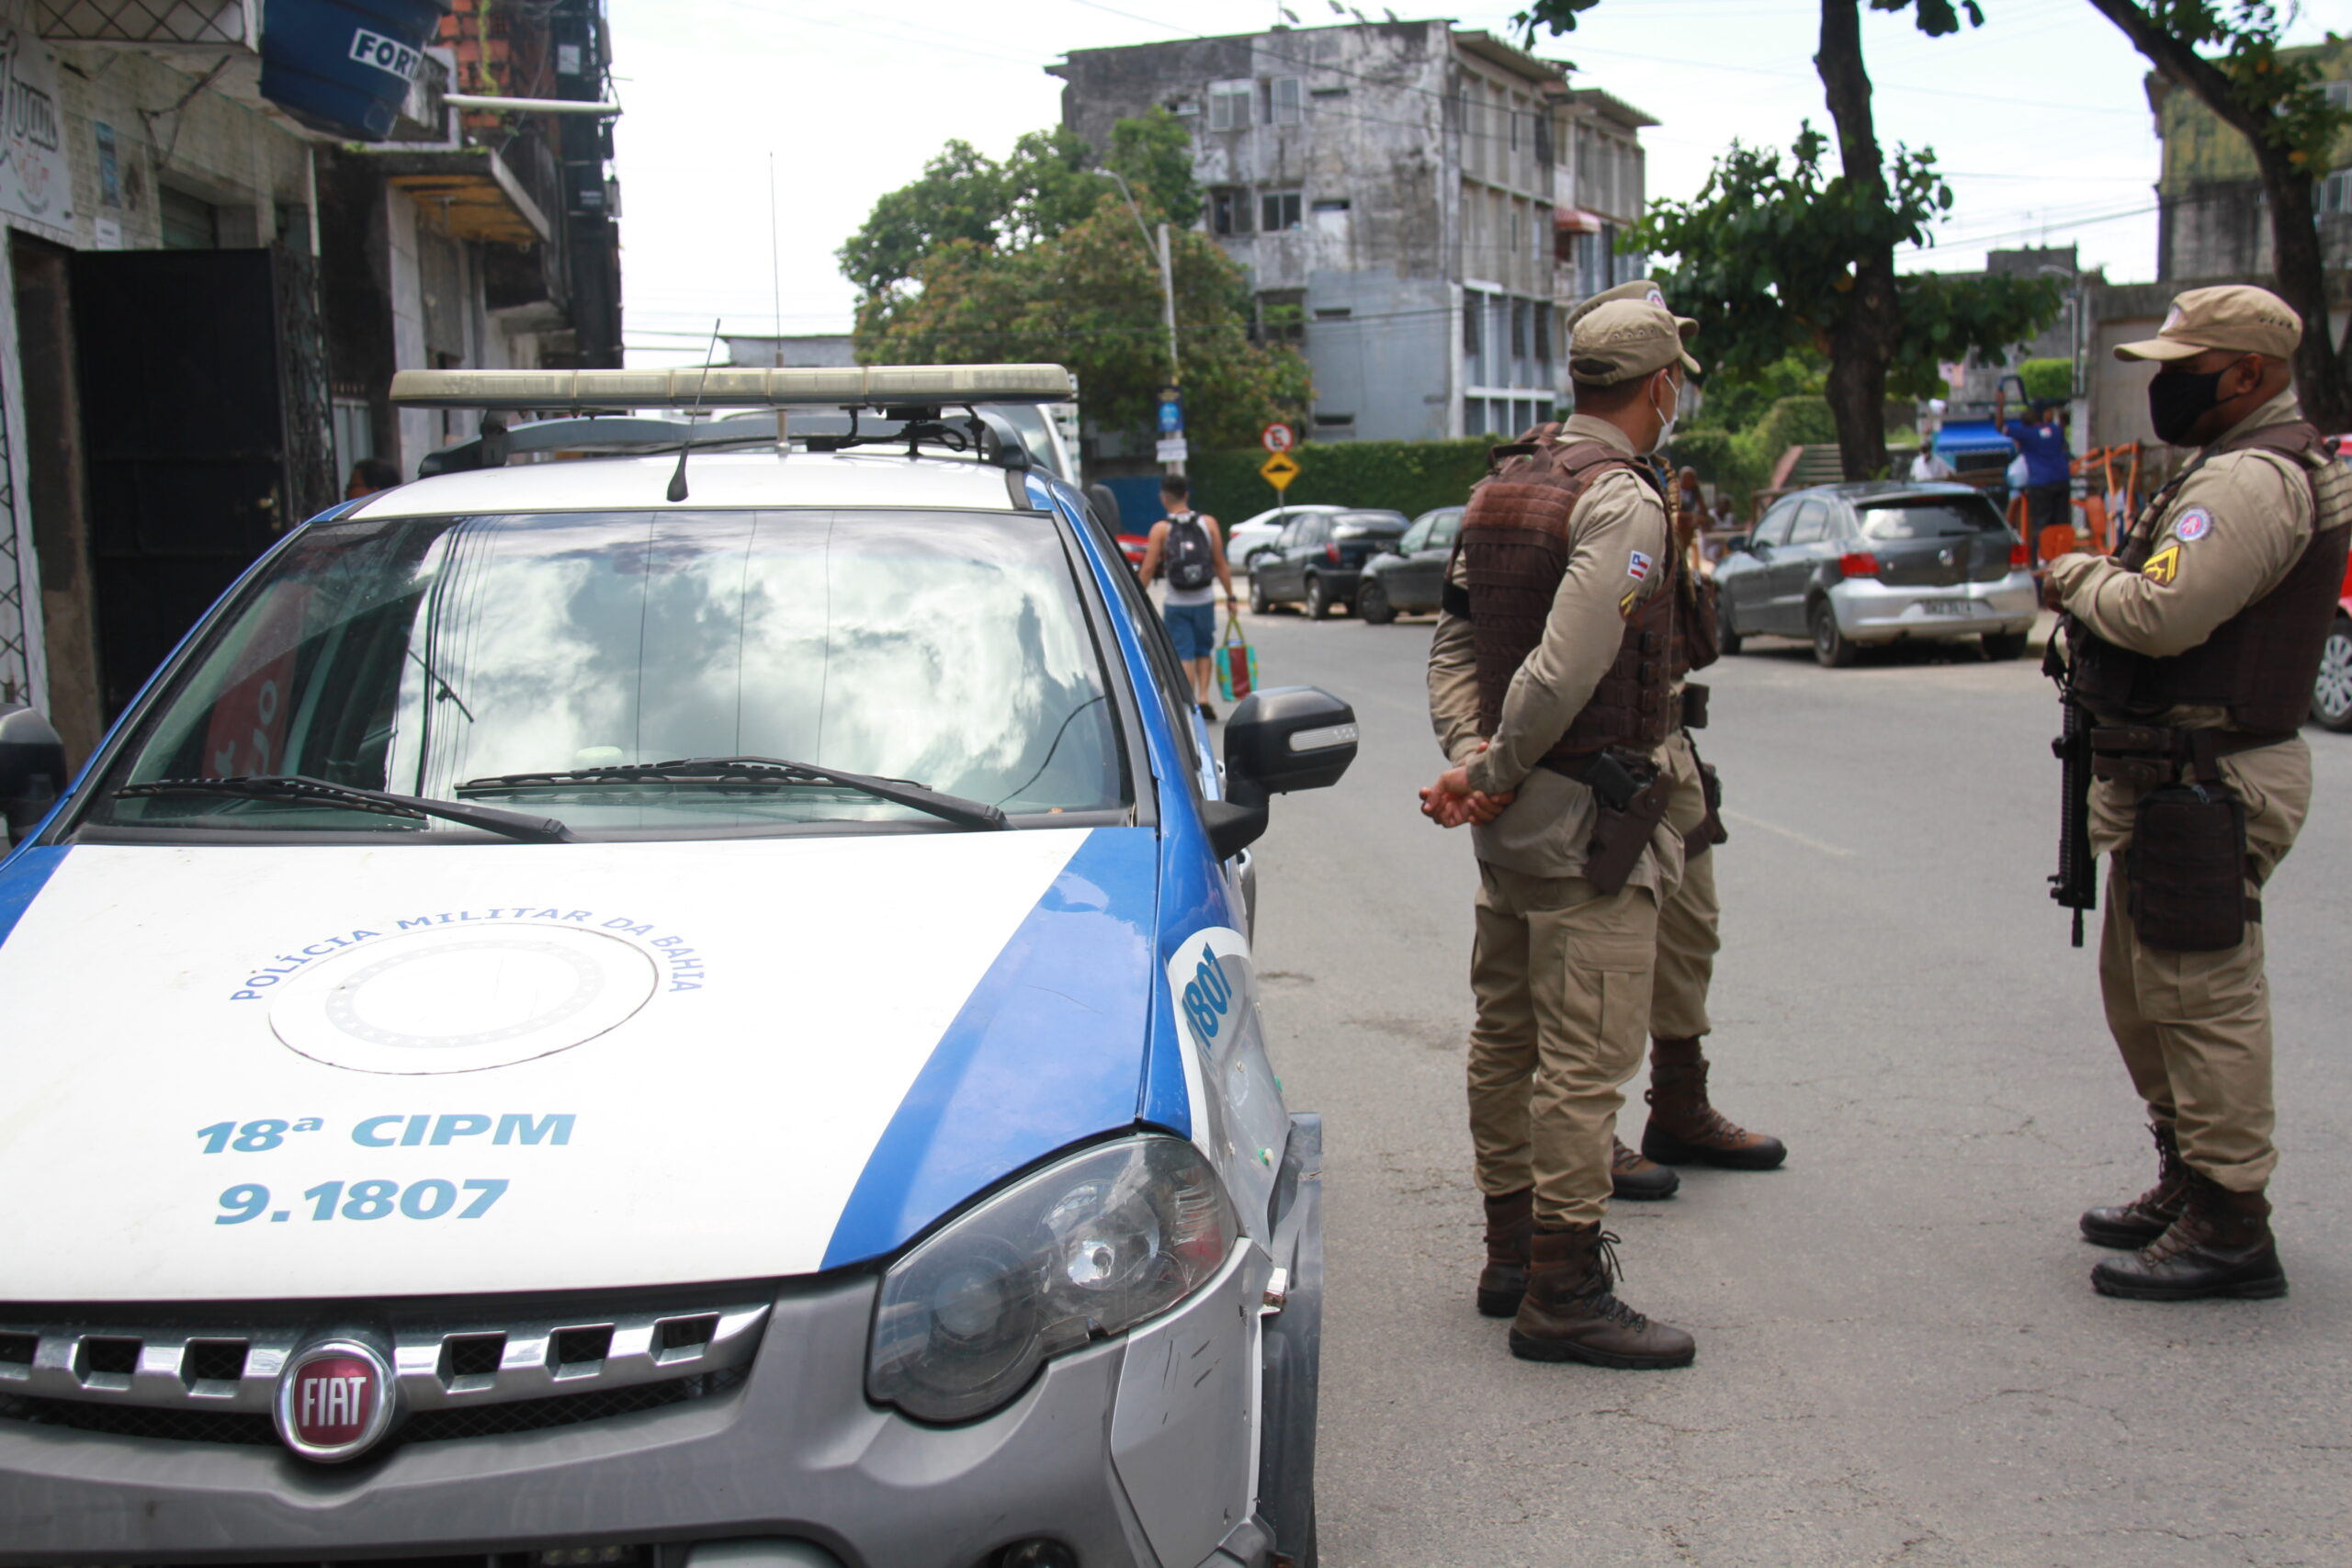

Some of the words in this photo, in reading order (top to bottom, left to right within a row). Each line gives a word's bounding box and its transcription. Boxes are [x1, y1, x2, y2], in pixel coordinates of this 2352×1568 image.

[230, 930, 382, 1000] POLÍCIA
[396, 908, 594, 930] MILITAR
[600, 917, 655, 937] DA
[650, 935, 705, 993] BAHIA
[351, 1113, 577, 1148] CIPM
[214, 1178, 511, 1225] 9.1807
[302, 1376, 368, 1427] FIAT
